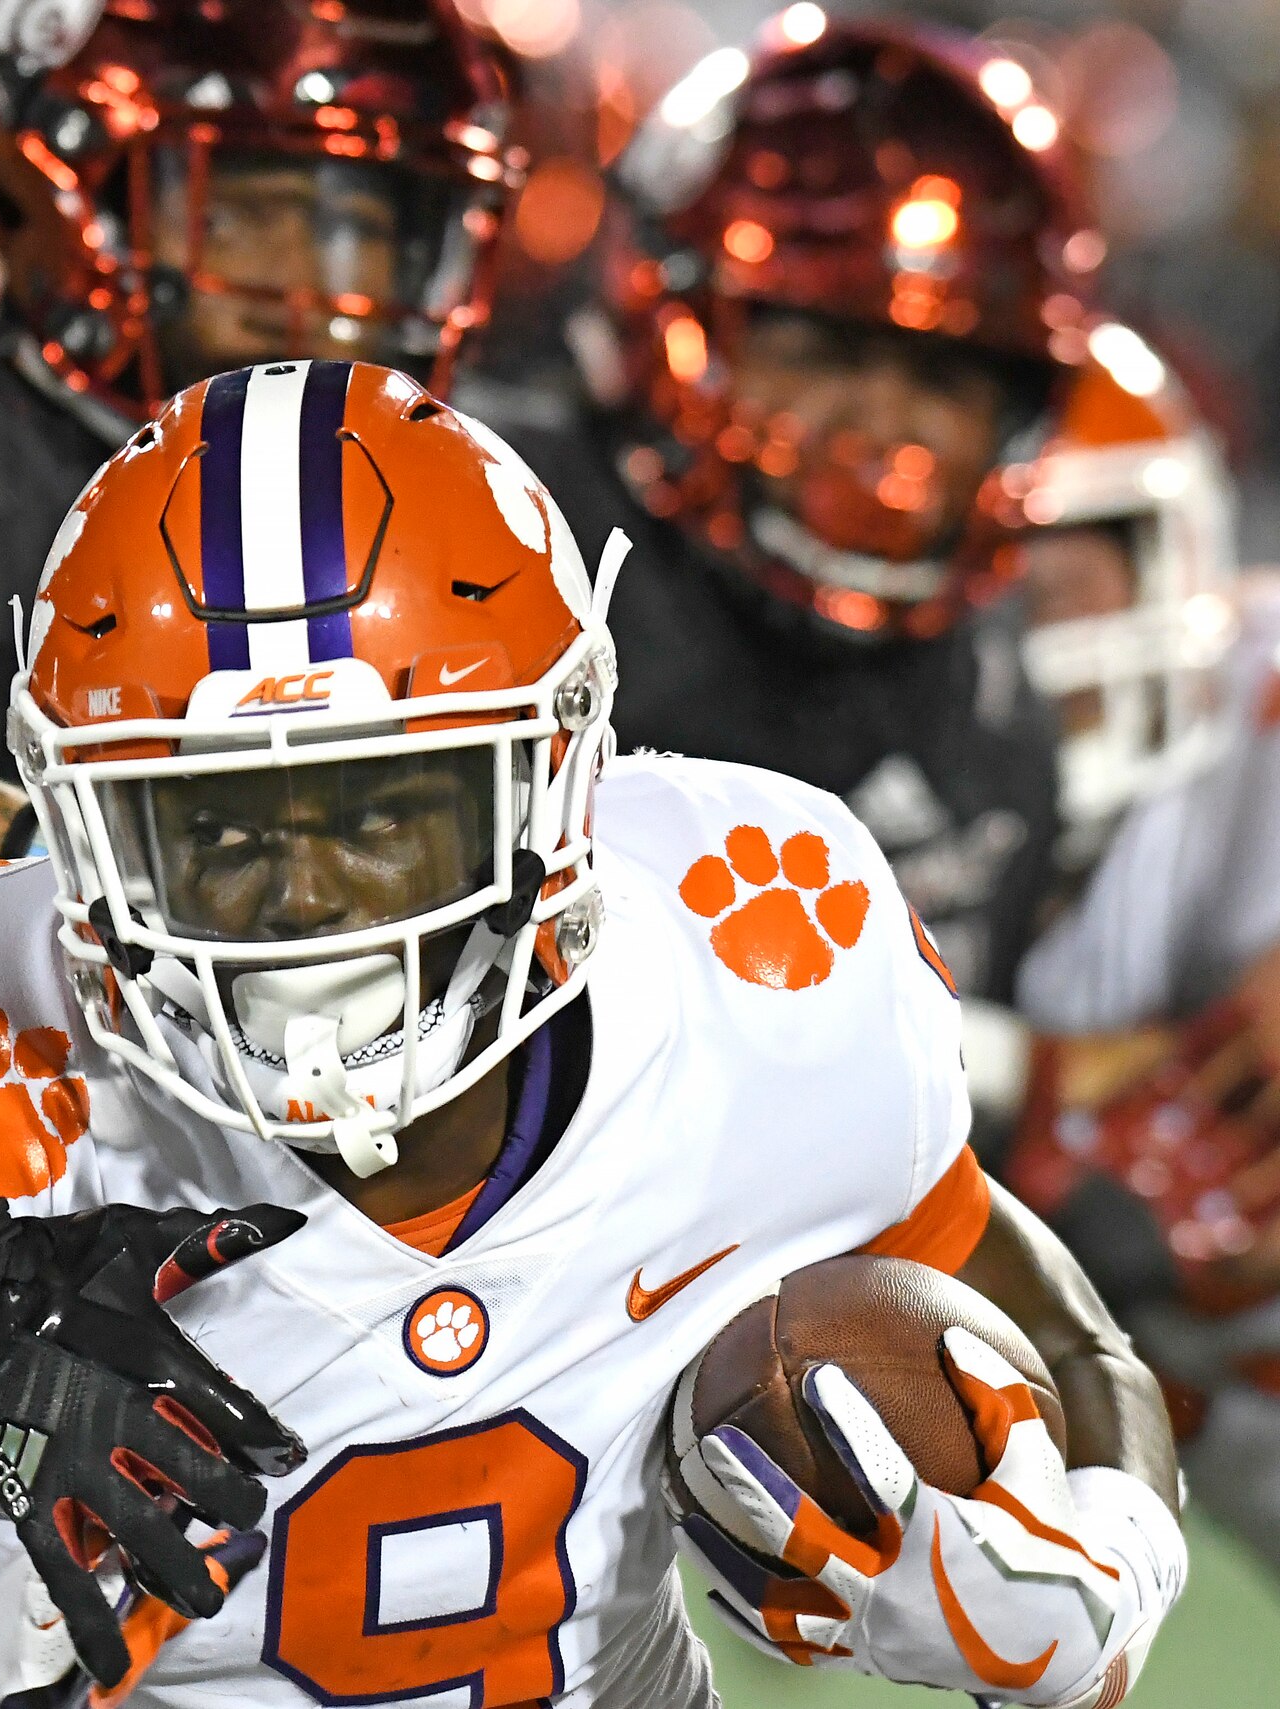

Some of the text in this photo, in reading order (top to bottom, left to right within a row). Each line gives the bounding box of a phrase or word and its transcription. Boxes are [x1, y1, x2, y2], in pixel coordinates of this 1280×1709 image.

[88, 686, 122, 717] NIKE
[236, 671, 335, 707] ACC
[260, 1406, 589, 1709] 9
